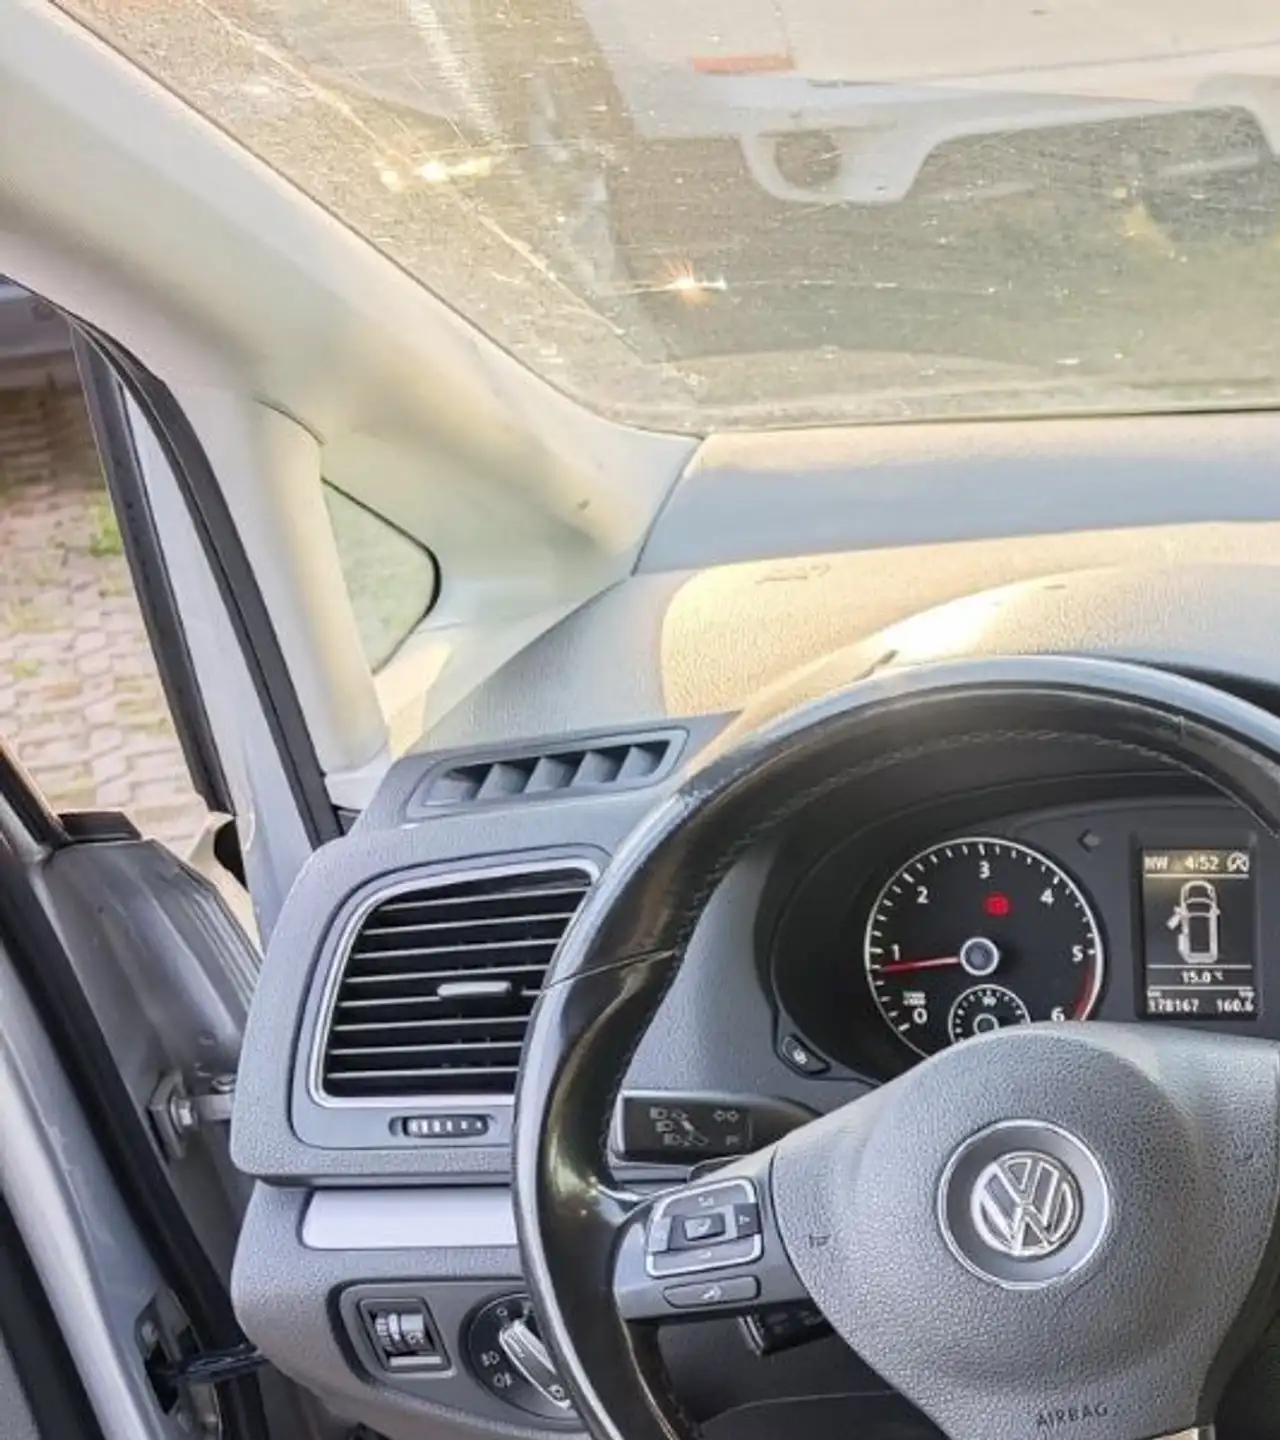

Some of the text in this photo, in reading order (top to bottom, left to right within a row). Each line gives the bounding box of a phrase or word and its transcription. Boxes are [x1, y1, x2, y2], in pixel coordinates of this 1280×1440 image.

[979, 861, 990, 878] 3
[916, 886, 929, 904] 2
[1040, 888, 1054, 905] 4
[892, 944, 900, 960] 1
[1072, 945, 1083, 962] 5
[912, 1007, 928, 1024] 0
[1051, 1006, 1065, 1022] 6
[1036, 1404, 1108, 1428] AIRBAG
